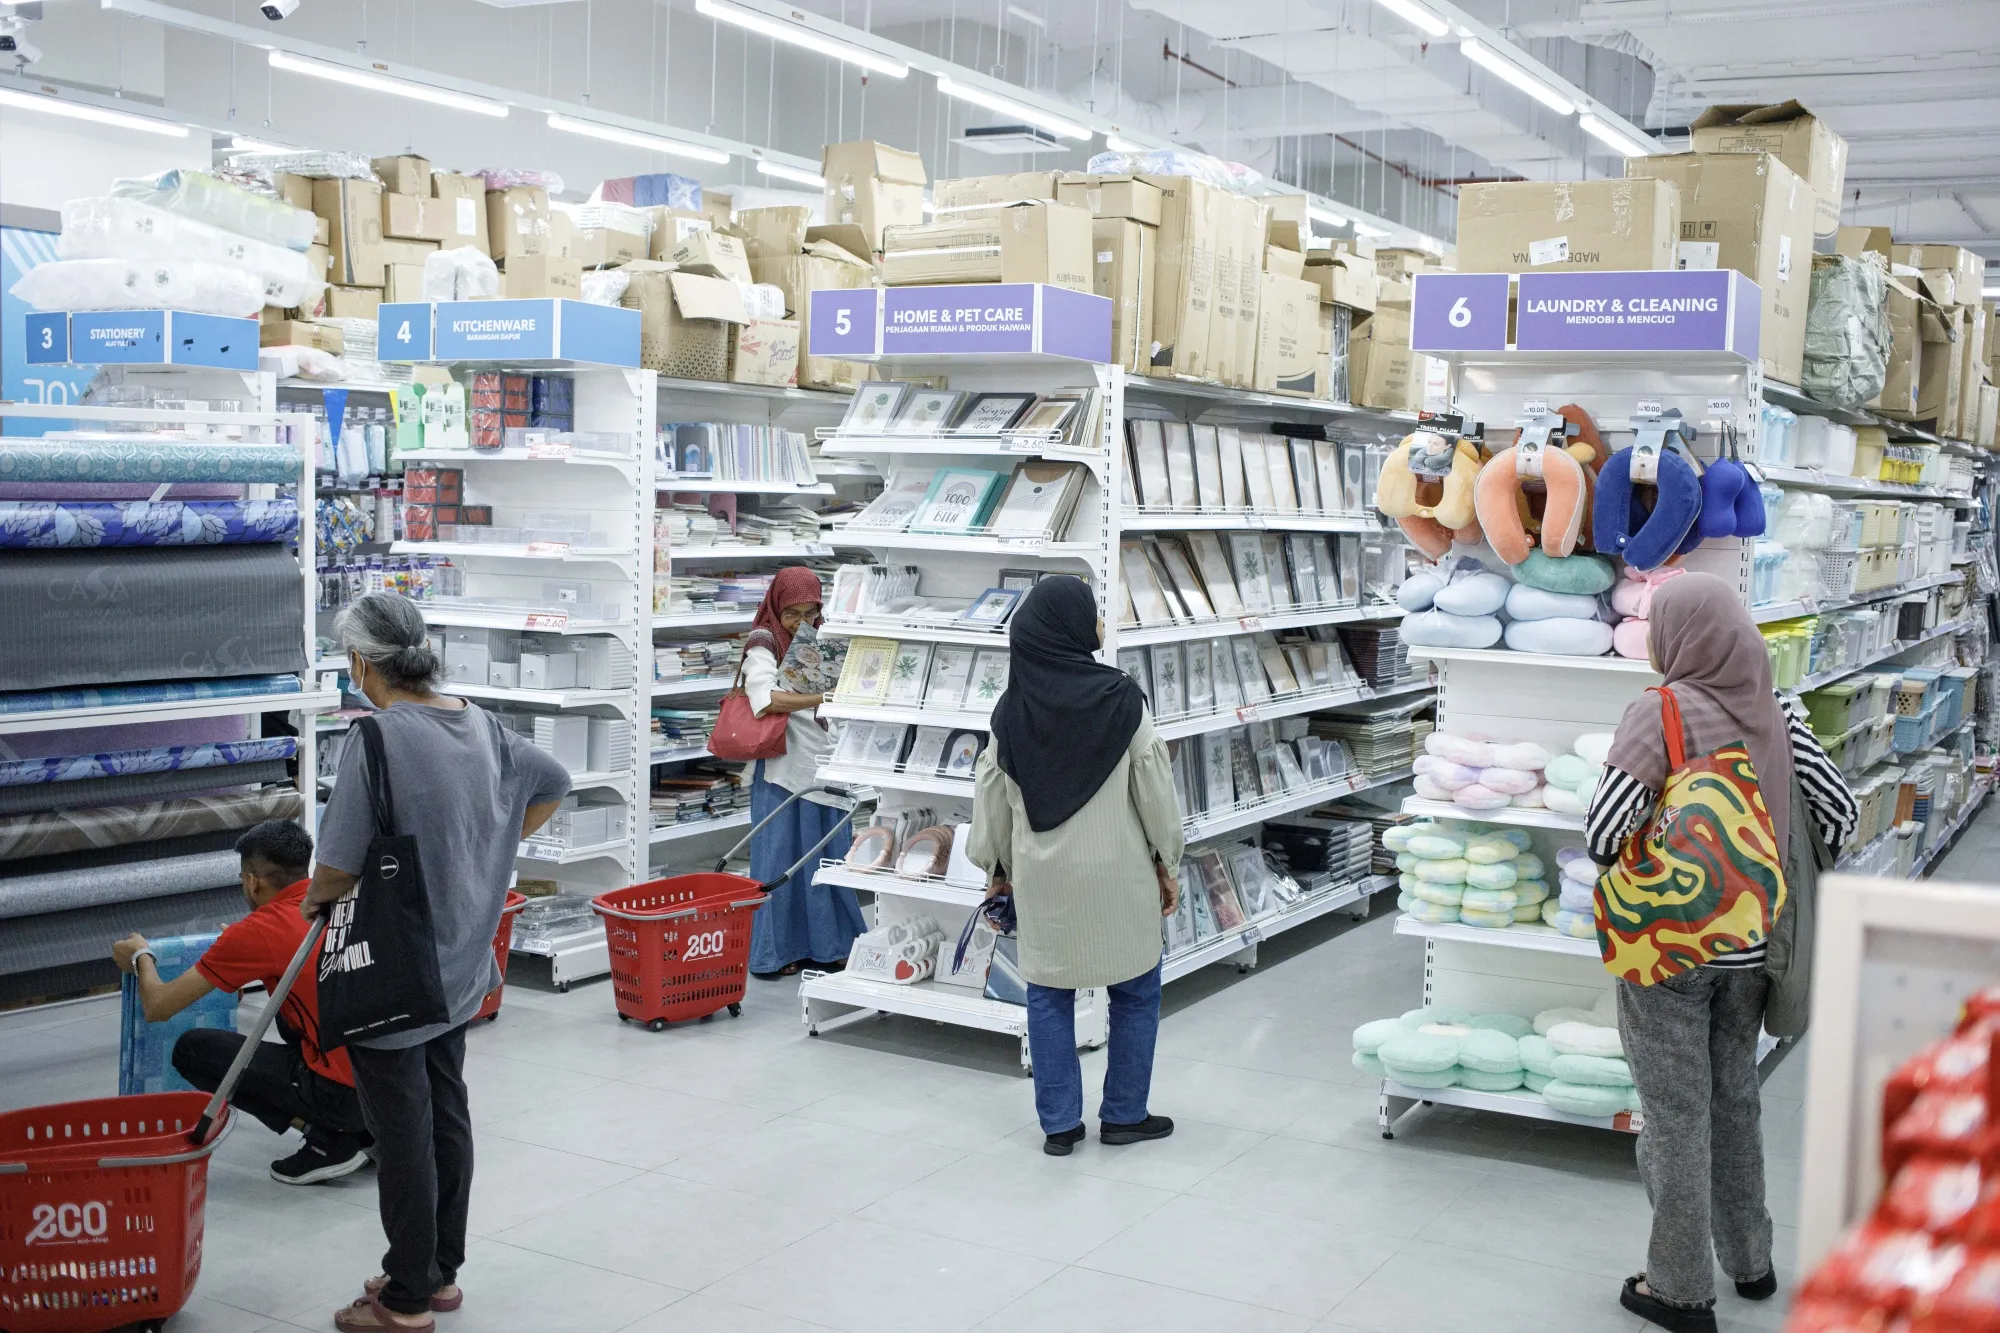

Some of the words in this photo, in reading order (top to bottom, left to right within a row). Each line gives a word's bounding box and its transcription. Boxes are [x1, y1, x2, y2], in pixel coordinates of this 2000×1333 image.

[1448, 297, 1472, 328] 6
[1527, 299, 1608, 313] LAUNDRY
[1611, 299, 1624, 313] &
[1629, 297, 1718, 313] CLEANING
[834, 309, 852, 336] 5
[893, 310, 938, 323] HOME
[940, 309, 952, 323] &
[955, 309, 982, 323] PET
[984, 308, 1023, 321] CARE
[1566, 315, 1615, 324] MENDOBI
[1617, 315, 1625, 324] &
[1627, 315, 1675, 324] MENCUCI
[396, 320, 412, 344] 4
[453, 319, 536, 332] KITCHENWARE
[885, 325, 929, 334] PENJAGAAN
[930, 325, 957, 333] RUMAH
[966, 324, 998, 332] PRODUK
[999, 323, 1031, 331] HAIWAN
[41, 326, 53, 349] 3
[90, 328, 146, 340] STATIONERY
[466, 333, 500, 341] BARANGAN
[24, 378, 79, 406] JO
[944, 493, 971, 506] TODO
